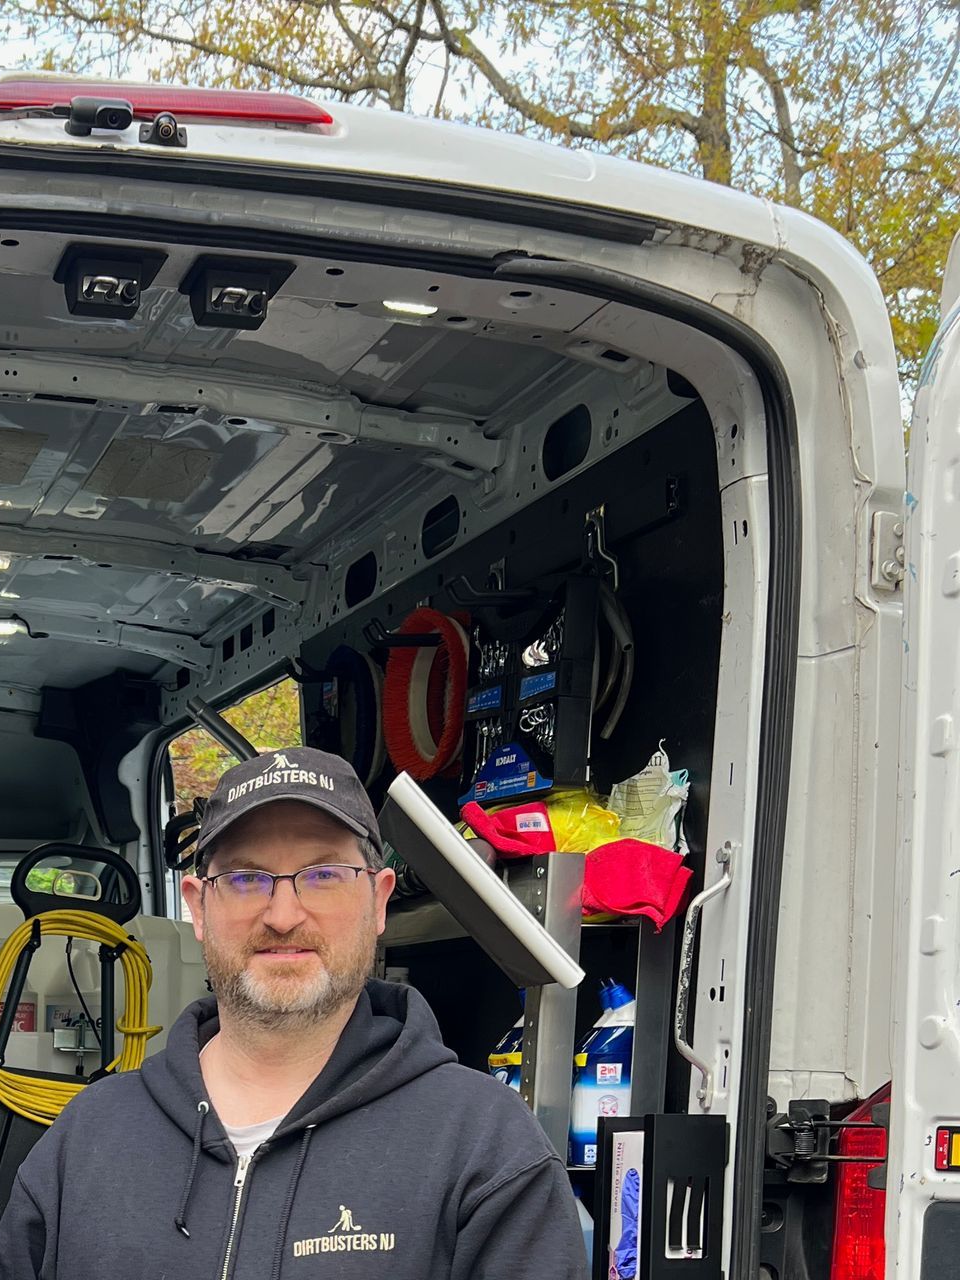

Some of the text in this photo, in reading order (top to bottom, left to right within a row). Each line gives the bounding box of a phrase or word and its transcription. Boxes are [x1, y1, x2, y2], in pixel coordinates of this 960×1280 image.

[228, 769, 335, 803] DIRTBUSTERS NJ
[293, 1233, 395, 1257] DIRTBUSTERS NJ
